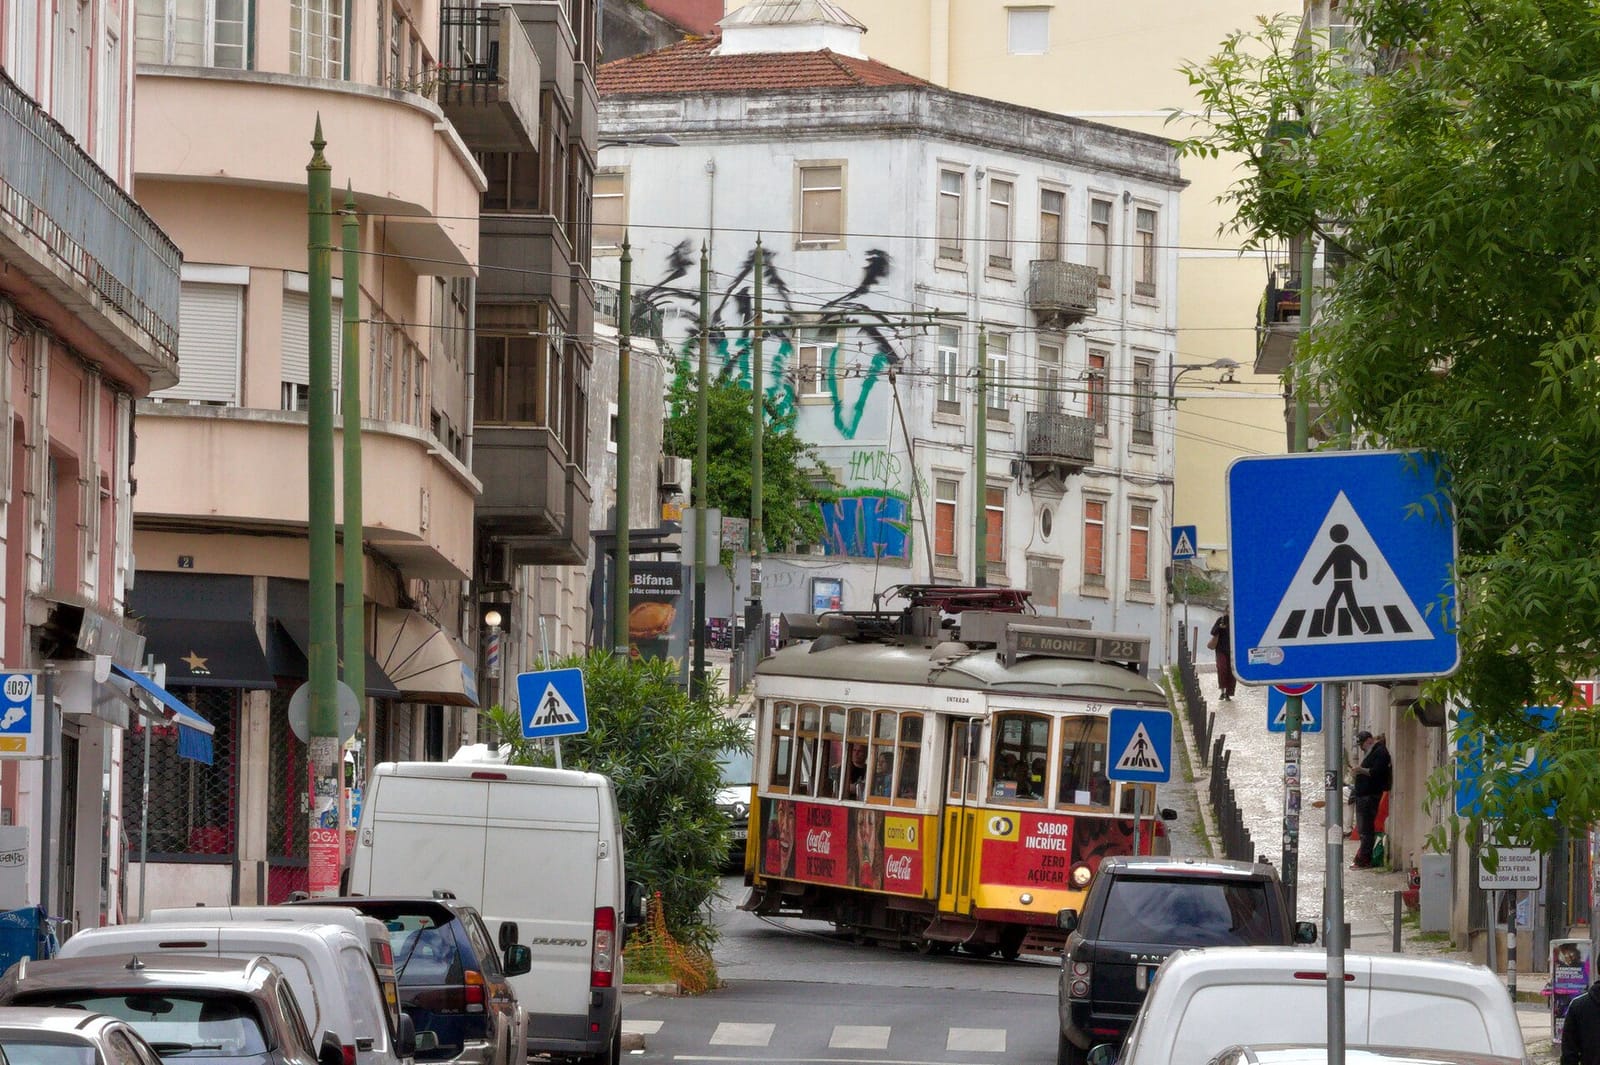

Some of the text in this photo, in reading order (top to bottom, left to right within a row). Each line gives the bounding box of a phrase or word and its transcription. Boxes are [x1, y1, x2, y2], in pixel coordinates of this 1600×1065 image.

[183, 557, 190, 568] 2
[634, 573, 673, 586] Bifana
[1040, 638, 1088, 652] MONIZ
[1109, 640, 1134, 657] 28
[11, 680, 30, 696] 037
[946, 695, 970, 704] ENTRADA
[1086, 703, 1102, 712] 567
[311, 830, 339, 843] OGA
[1037, 822, 1068, 837] SABOR
[1025, 835, 1067, 852] INCRÍVEL
[1041, 854, 1065, 868] ZERO
